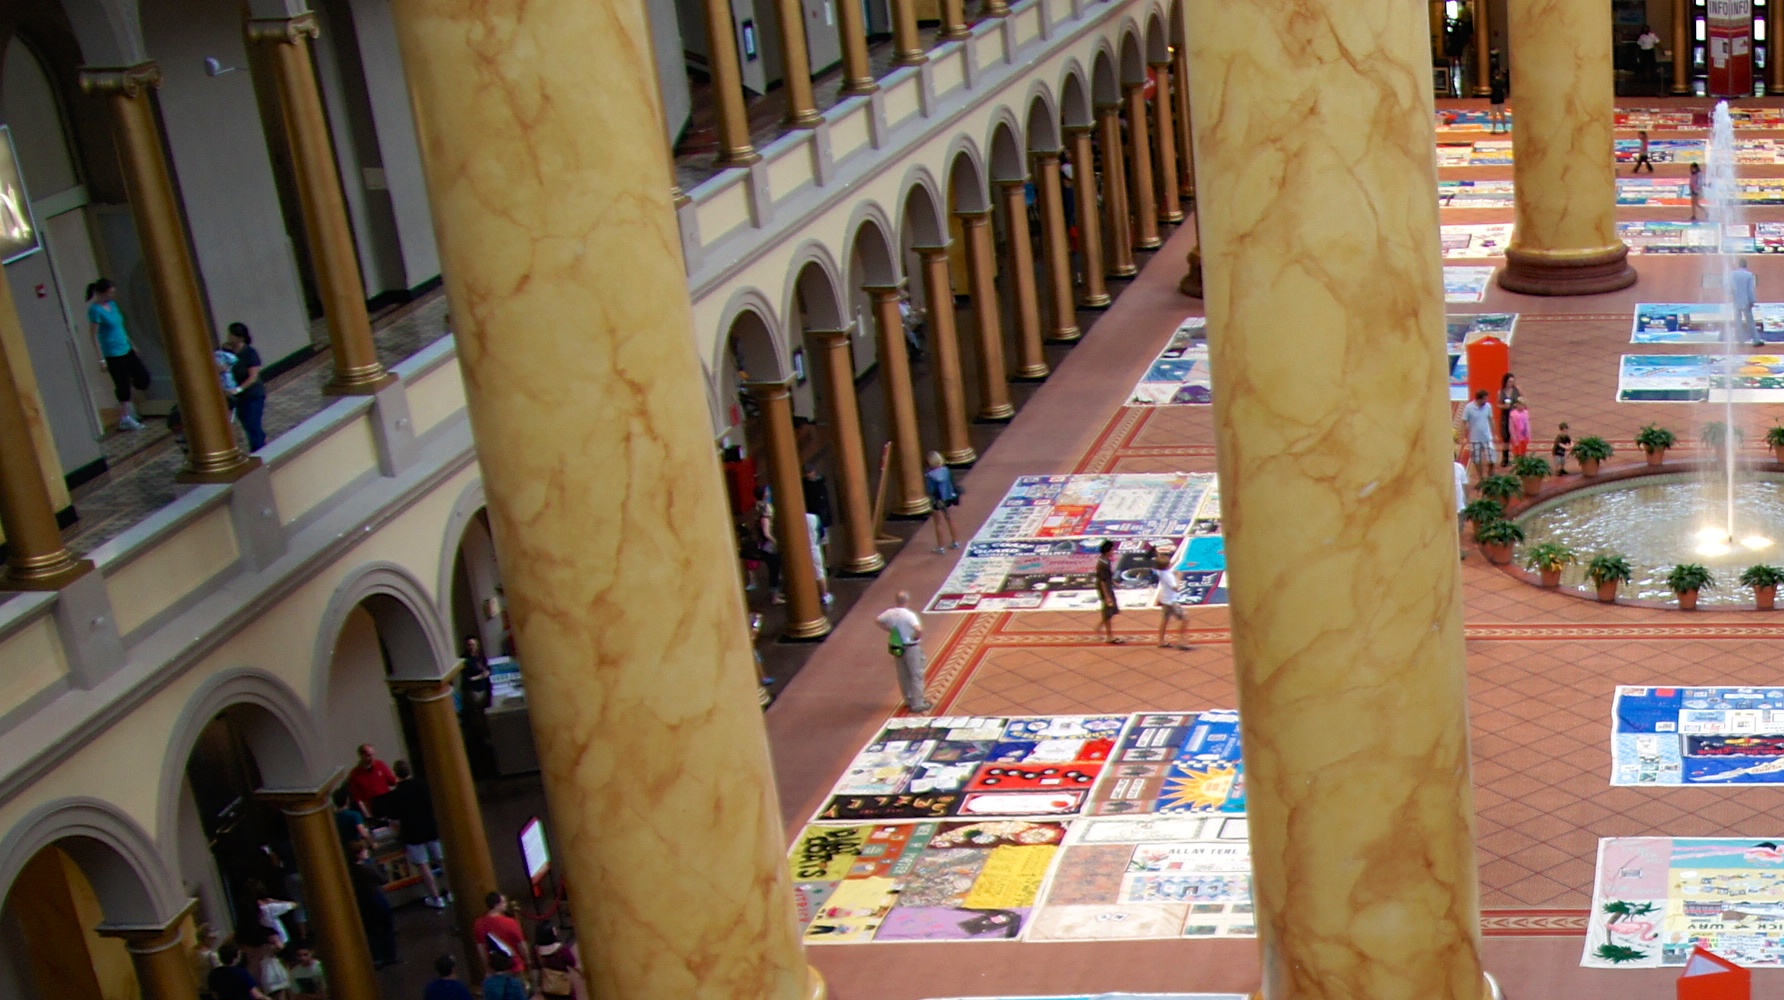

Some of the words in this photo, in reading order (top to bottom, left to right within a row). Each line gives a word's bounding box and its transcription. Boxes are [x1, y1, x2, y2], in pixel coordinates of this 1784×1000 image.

[1708, 1, 1729, 16] INFO
[1729, 0, 1749, 15] INFO
[1687, 923, 1725, 931] WAY
